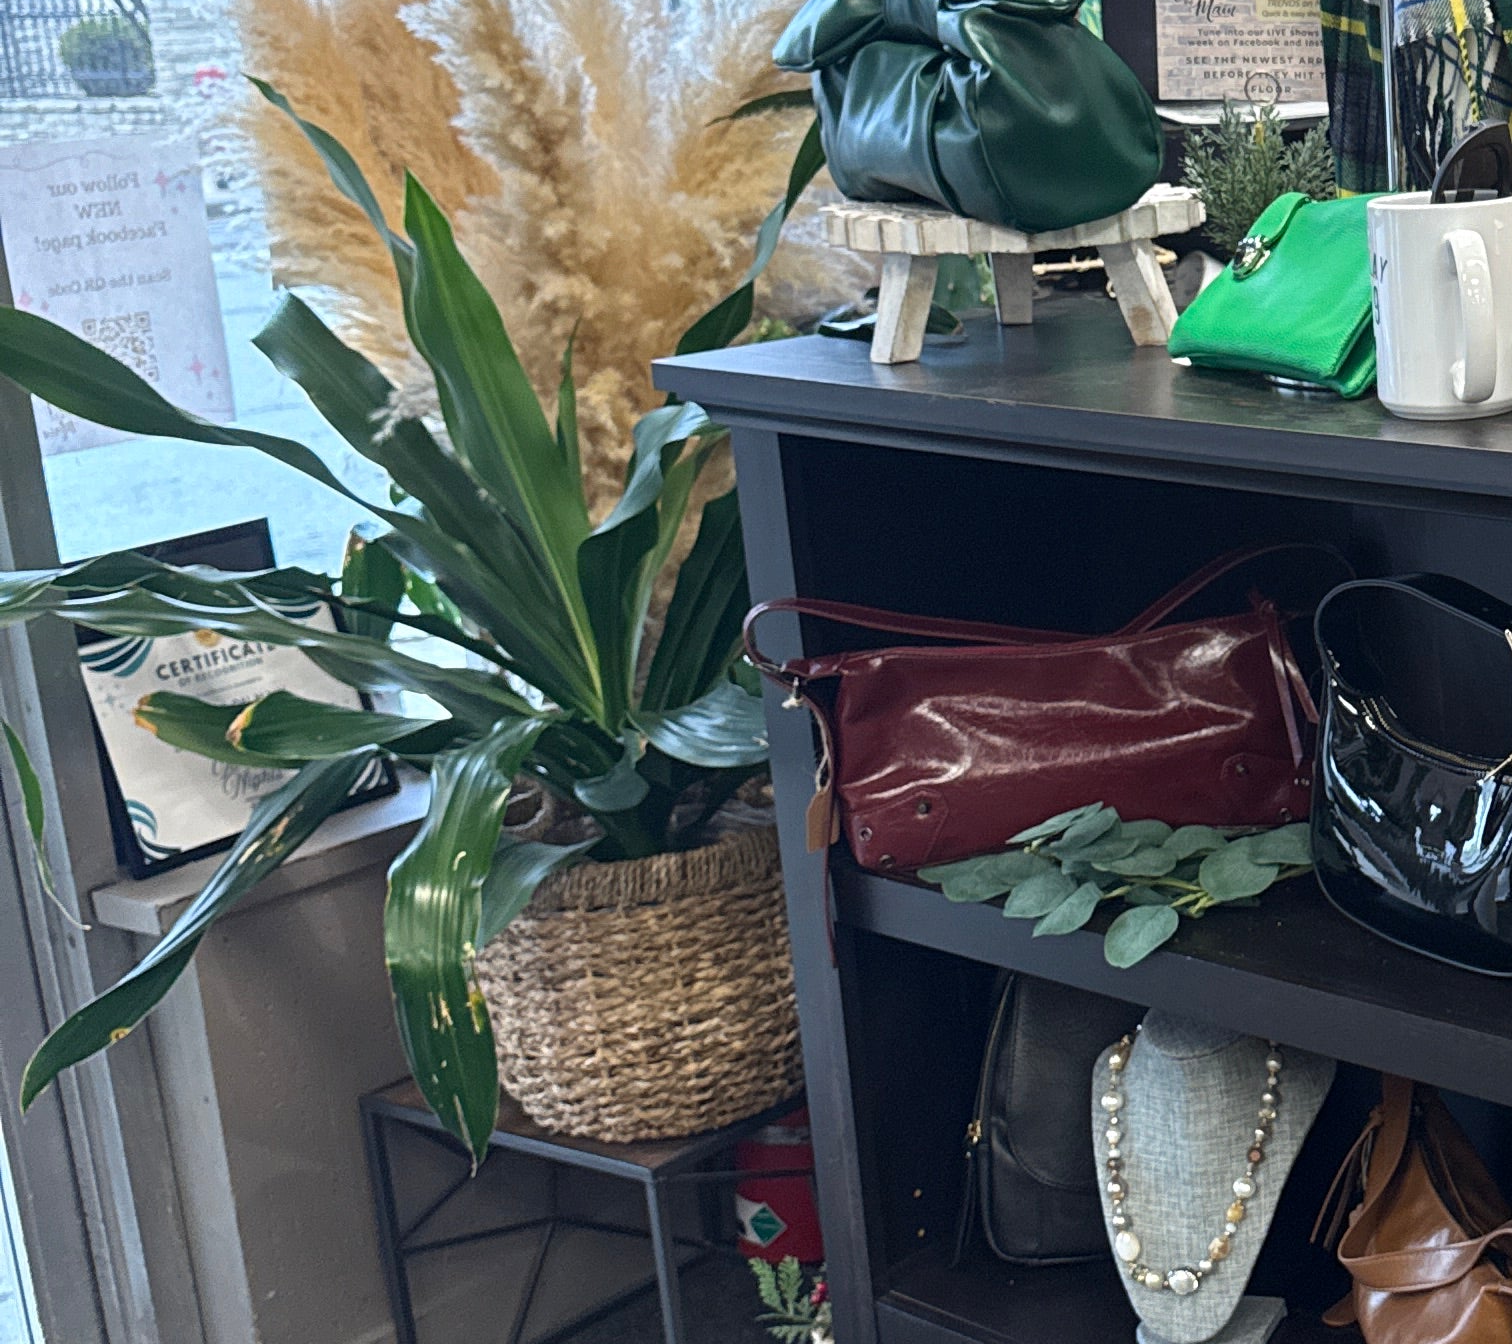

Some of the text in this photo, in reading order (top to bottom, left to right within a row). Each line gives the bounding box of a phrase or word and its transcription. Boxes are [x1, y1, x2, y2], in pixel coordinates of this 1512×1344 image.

[1198, 28, 1221, 36] Tune
[1224, 28, 1245, 37] into
[1267, 28, 1287, 37] LIVE
[1188, 38, 1214, 47] week
[1234, 38, 1280, 47] Facebook
[1284, 38, 1302, 47] and
[1186, 56, 1208, 64] SEE
[1214, 56, 1236, 65] THE
[1242, 56, 1293, 65] NEWEST
[1203, 71, 1250, 79] BEFORE
[1294, 72, 1314, 80] HIT
